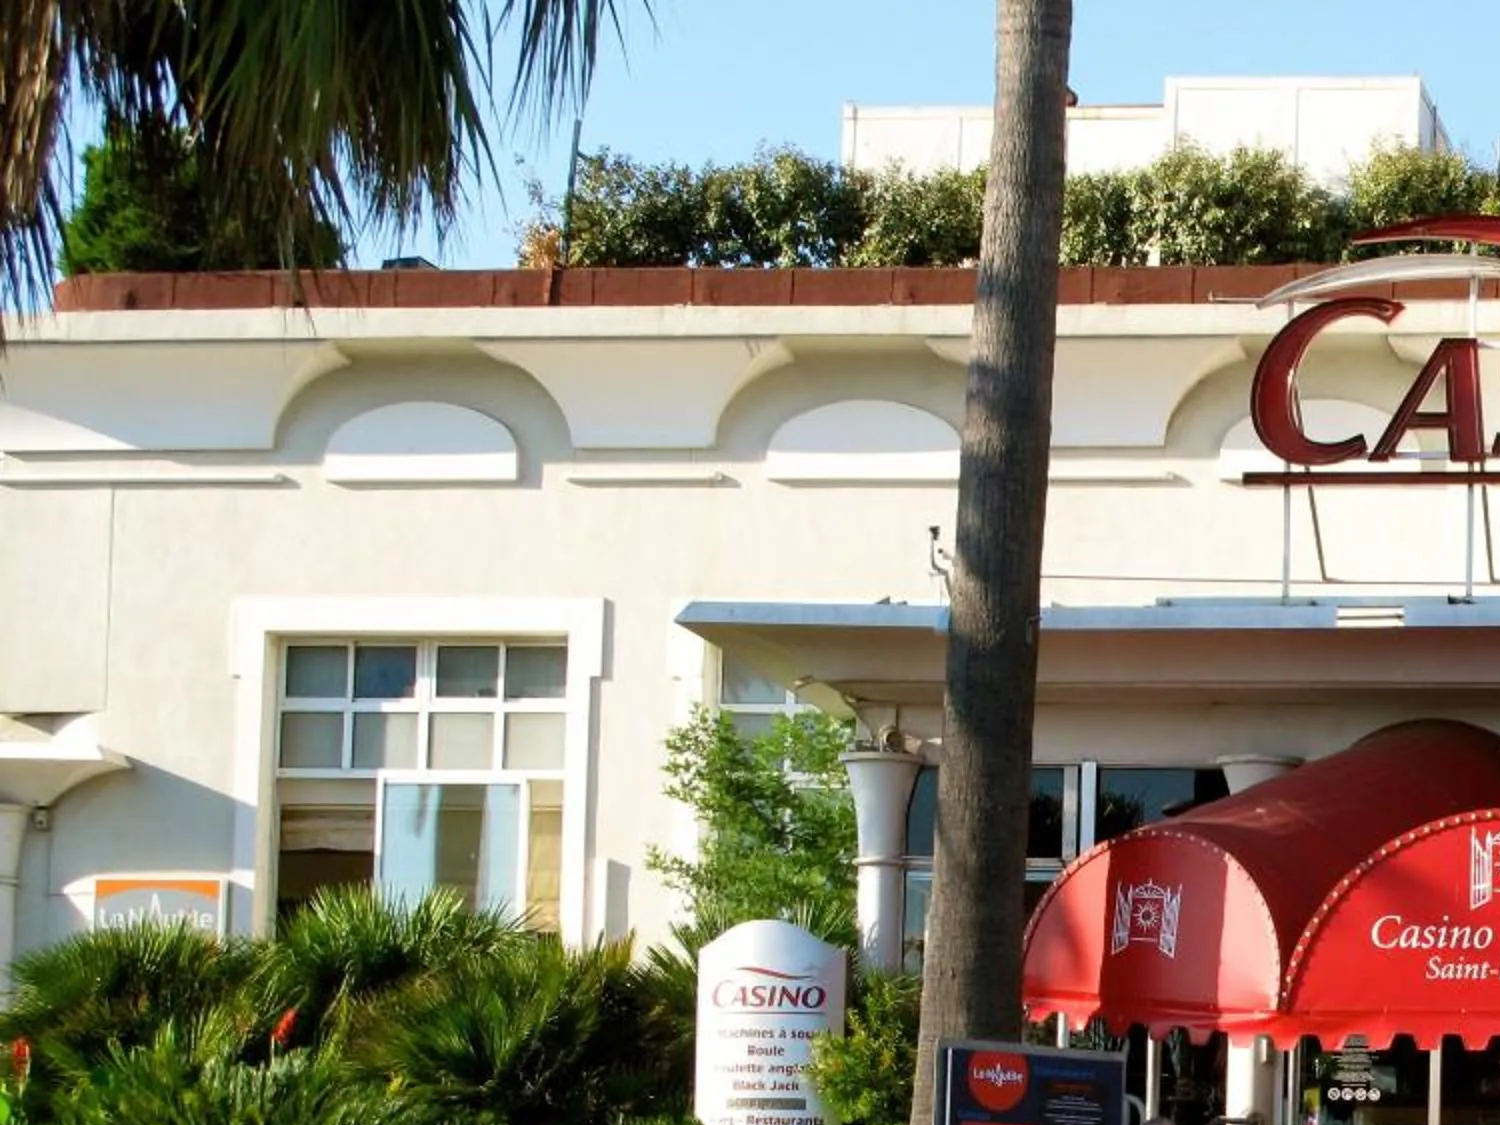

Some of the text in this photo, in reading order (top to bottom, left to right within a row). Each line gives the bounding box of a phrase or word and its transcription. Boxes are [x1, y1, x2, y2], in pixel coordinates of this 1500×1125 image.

[1371, 914, 1494, 950] Casino
[712, 979, 828, 1010] CASINO
[731, 1080, 800, 1092] Black Jack
